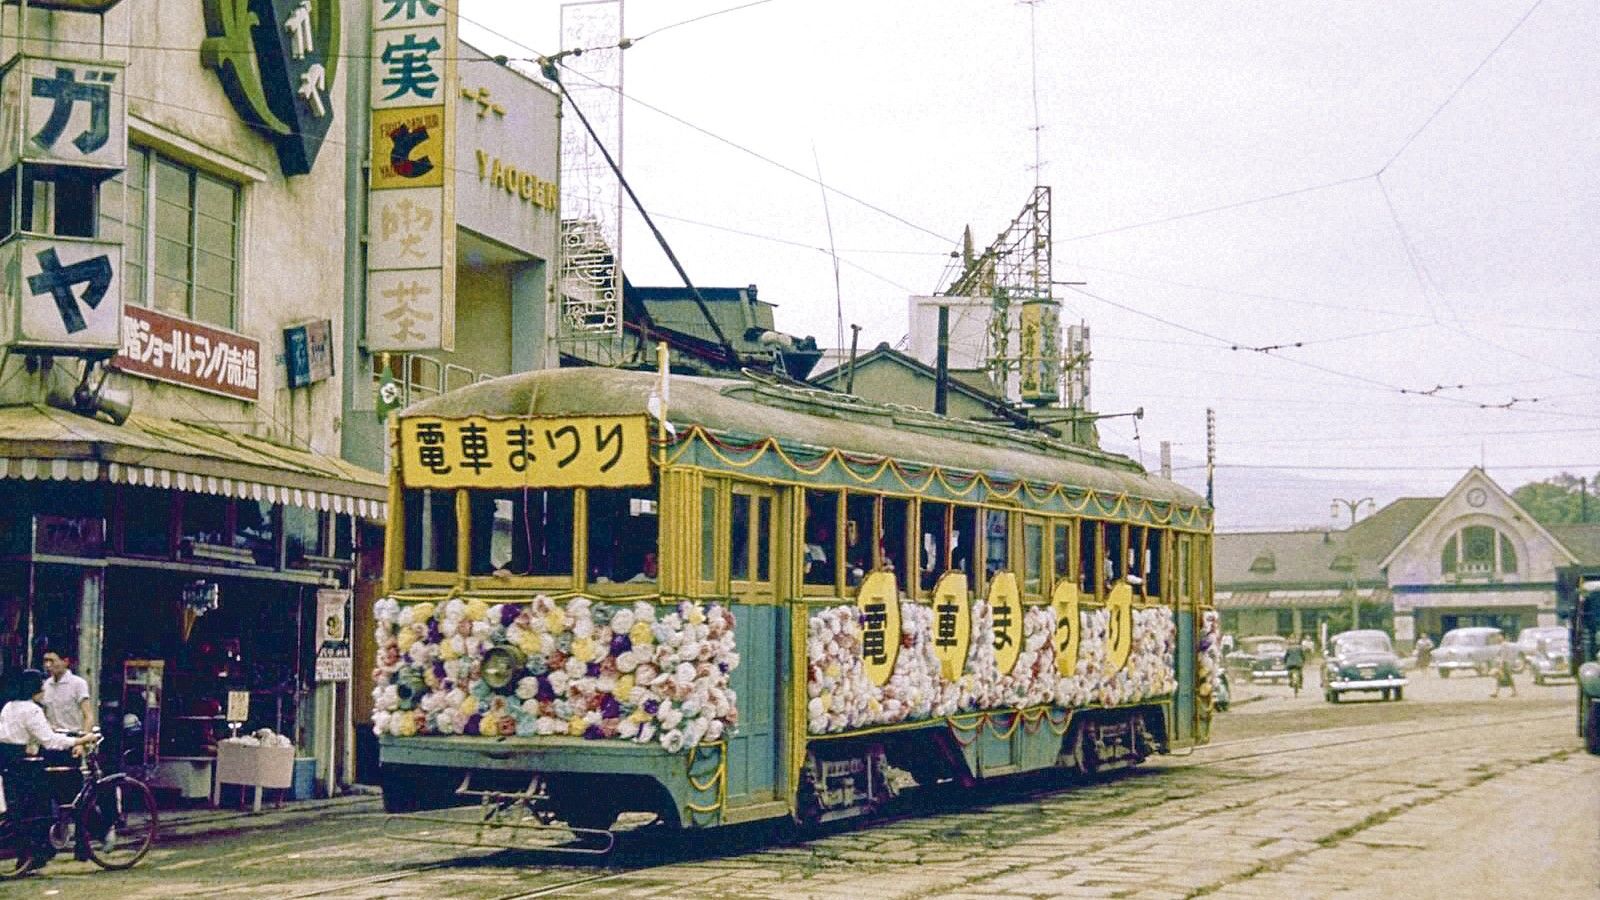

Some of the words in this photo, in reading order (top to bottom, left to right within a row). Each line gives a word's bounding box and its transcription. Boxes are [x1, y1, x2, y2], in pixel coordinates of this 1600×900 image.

[456, 84, 506, 119] ーラー
[27, 67, 117, 334] ガヤ
[416, 422, 623, 475] 電車まつり
